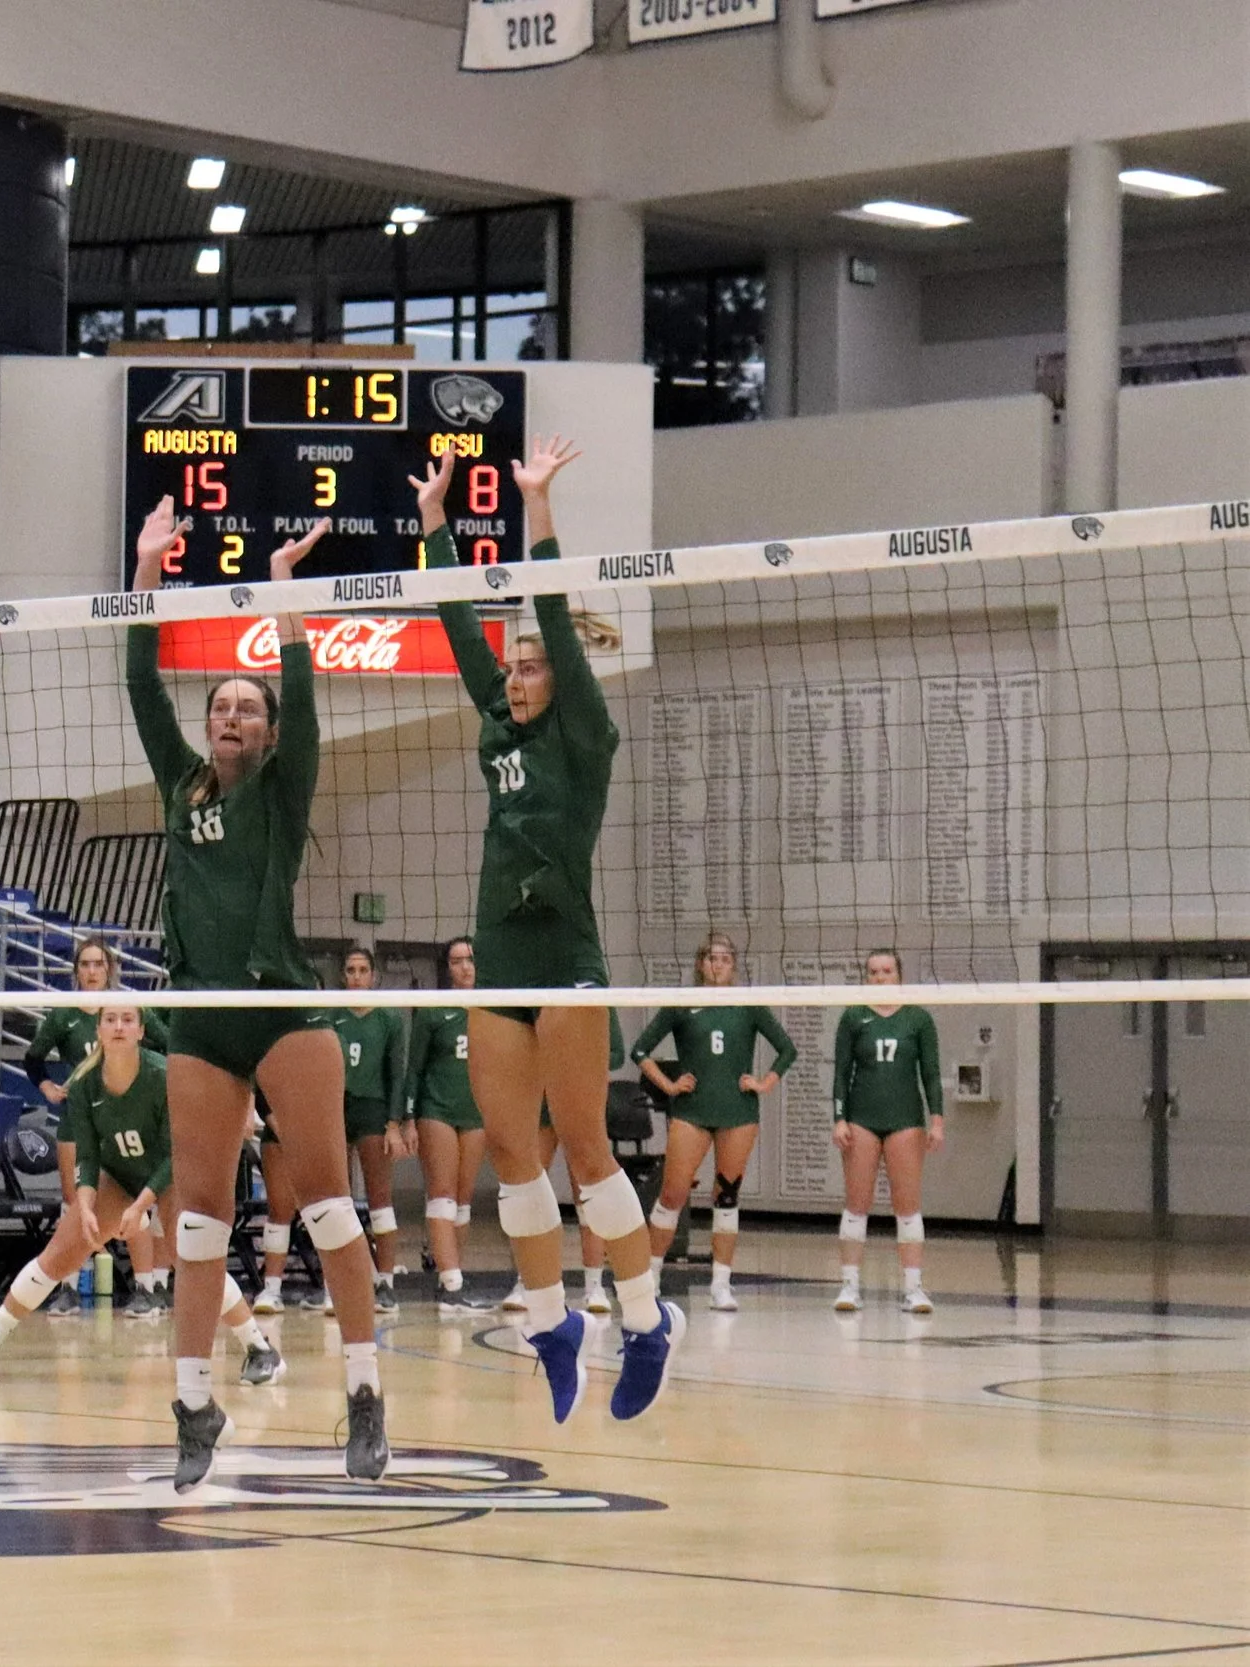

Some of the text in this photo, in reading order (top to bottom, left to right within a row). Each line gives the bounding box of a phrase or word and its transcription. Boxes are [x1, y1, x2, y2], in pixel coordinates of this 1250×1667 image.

[641, 0, 758, 26] 2003-2
[507, 12, 556, 50] 2012
[144, 429, 237, 455] AUGUSTA
[297, 445, 353, 462] PERIOD
[430, 432, 483, 458] GCSU
[184, 461, 227, 510] 15
[314, 467, 336, 507] 3
[469, 464, 499, 514] 8
[214, 516, 256, 533] T.O.L.
[274, 516, 378, 535] PLAY FOUL
[395, 518, 423, 536] T.O.
[455, 519, 506, 536] FOULS
[1211, 502, 1250, 530] AUG
[161, 536, 186, 573] 2
[220, 535, 244, 574] 2
[888, 526, 973, 558] AUGUSTA
[598, 551, 675, 581] AUGUSTA
[333, 574, 403, 602] AUGUSTA
[91, 592, 156, 619] AUGUSTA
[236, 617, 408, 670] Co-Cola
[491, 749, 526, 794] 10
[711, 1030, 725, 1055] 6
[876, 1038, 898, 1062] 17
[114, 1129, 145, 1158] 19
